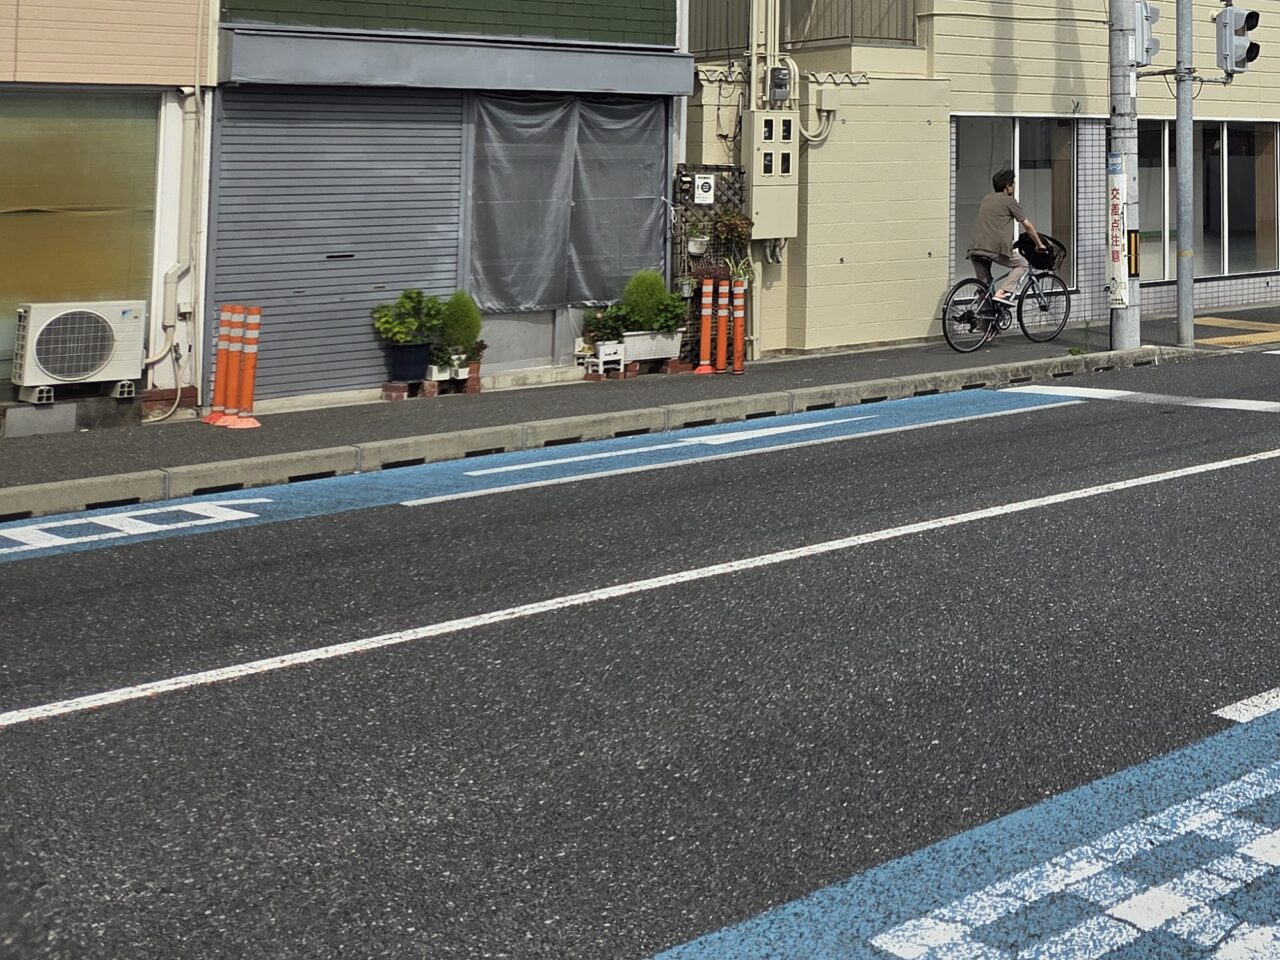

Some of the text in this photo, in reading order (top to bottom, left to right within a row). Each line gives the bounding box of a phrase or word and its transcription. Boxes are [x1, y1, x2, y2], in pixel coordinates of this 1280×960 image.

[1110, 188, 1121, 263] 交差点注意
